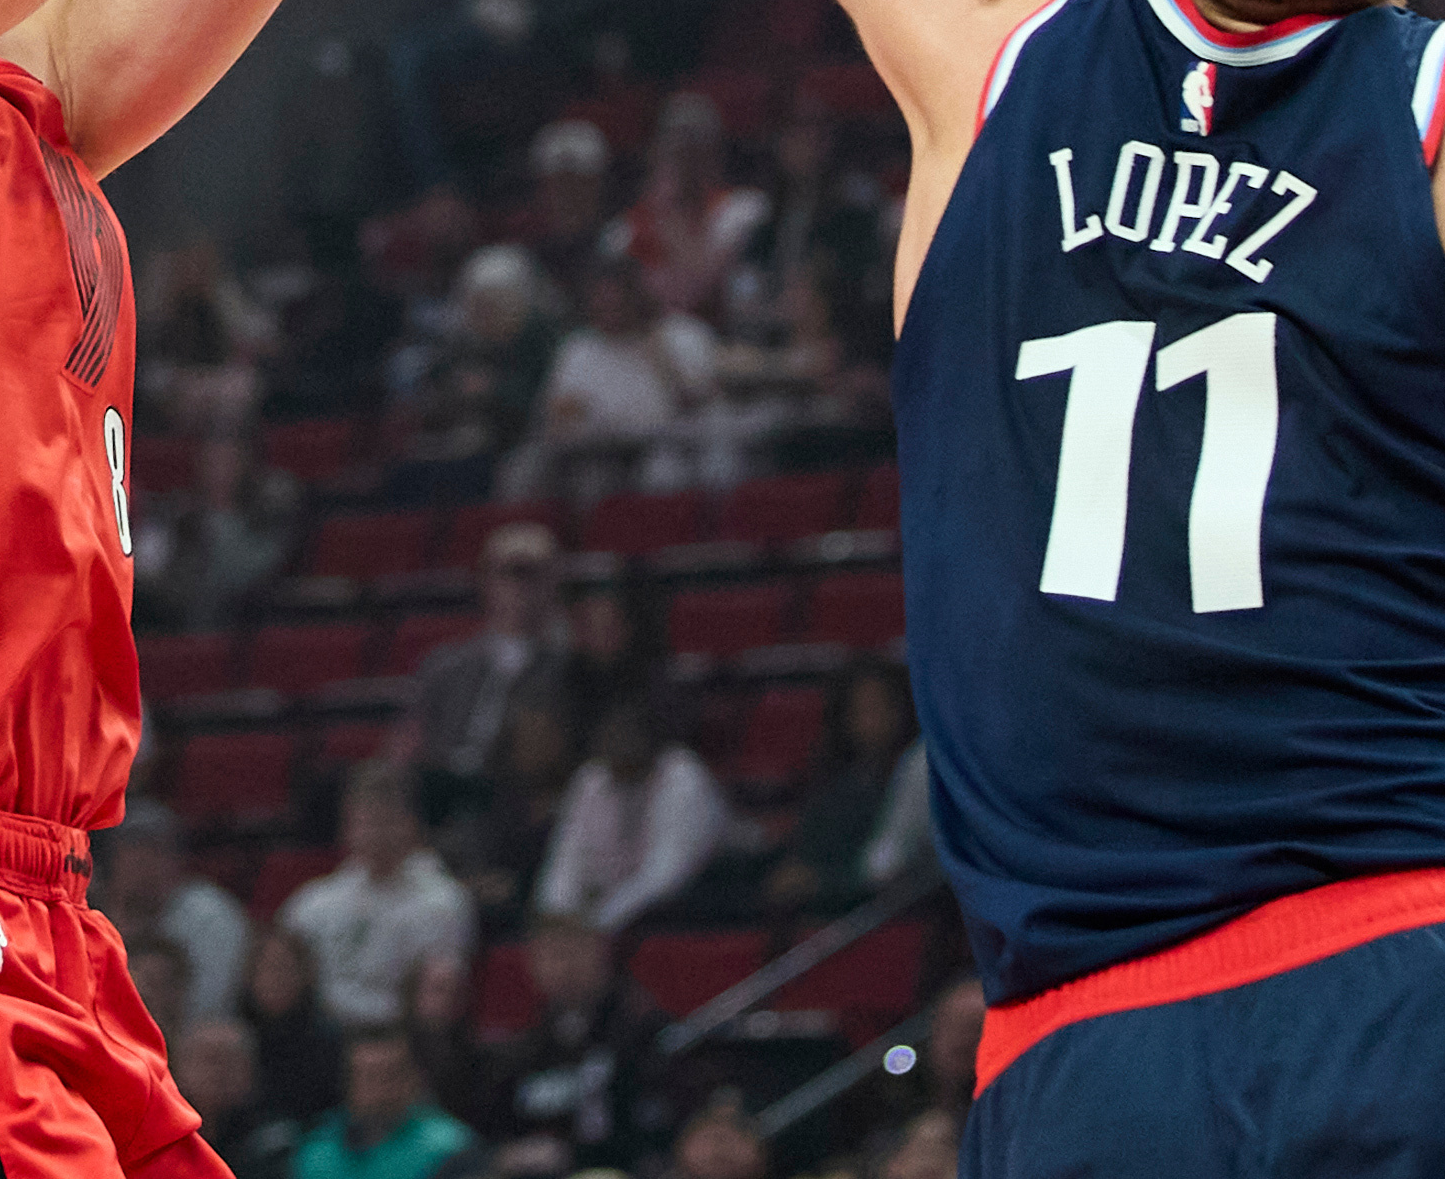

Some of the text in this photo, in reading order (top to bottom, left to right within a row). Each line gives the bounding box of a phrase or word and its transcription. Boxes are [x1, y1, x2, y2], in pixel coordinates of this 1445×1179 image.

[1049, 140, 1318, 283] LOPEZ
[104, 406, 132, 556] 8
[1015, 311, 1279, 613] 11
